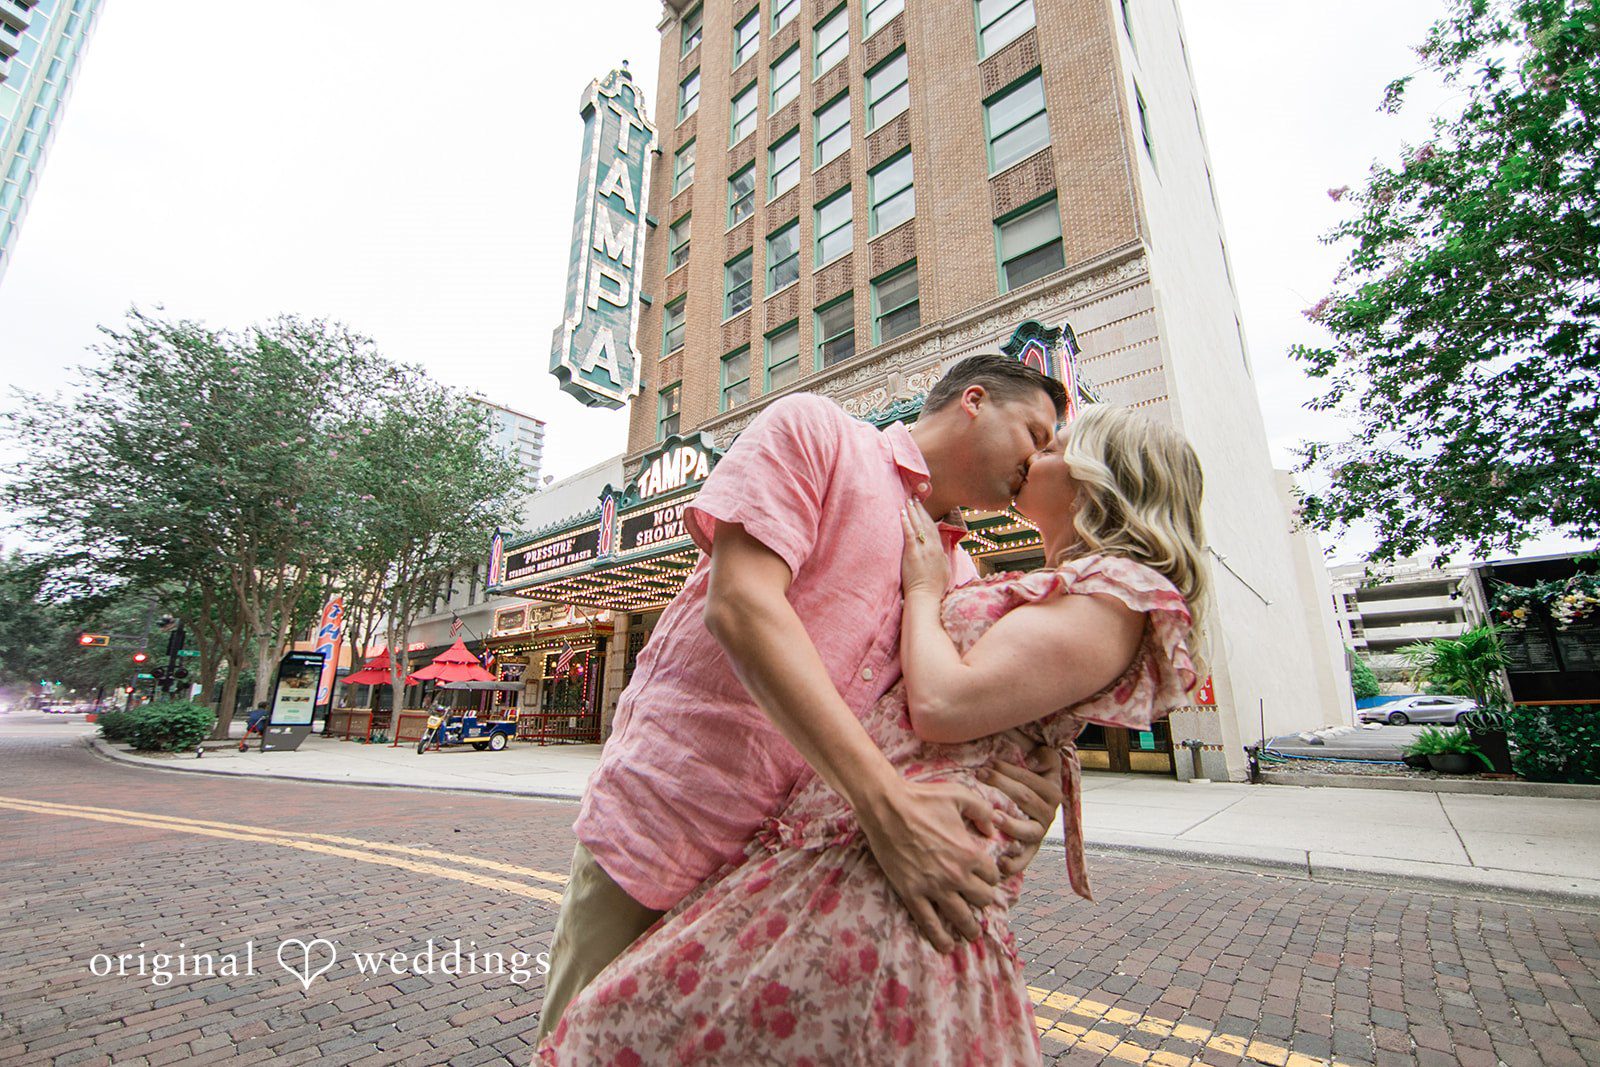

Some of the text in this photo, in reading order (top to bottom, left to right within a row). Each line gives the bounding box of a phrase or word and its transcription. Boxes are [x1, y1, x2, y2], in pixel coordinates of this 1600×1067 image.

[580, 97, 644, 386] TAMPA
[637, 446, 709, 499] TAMPA
[636, 520, 687, 546] SHOWI
[316, 604, 341, 668] THA
